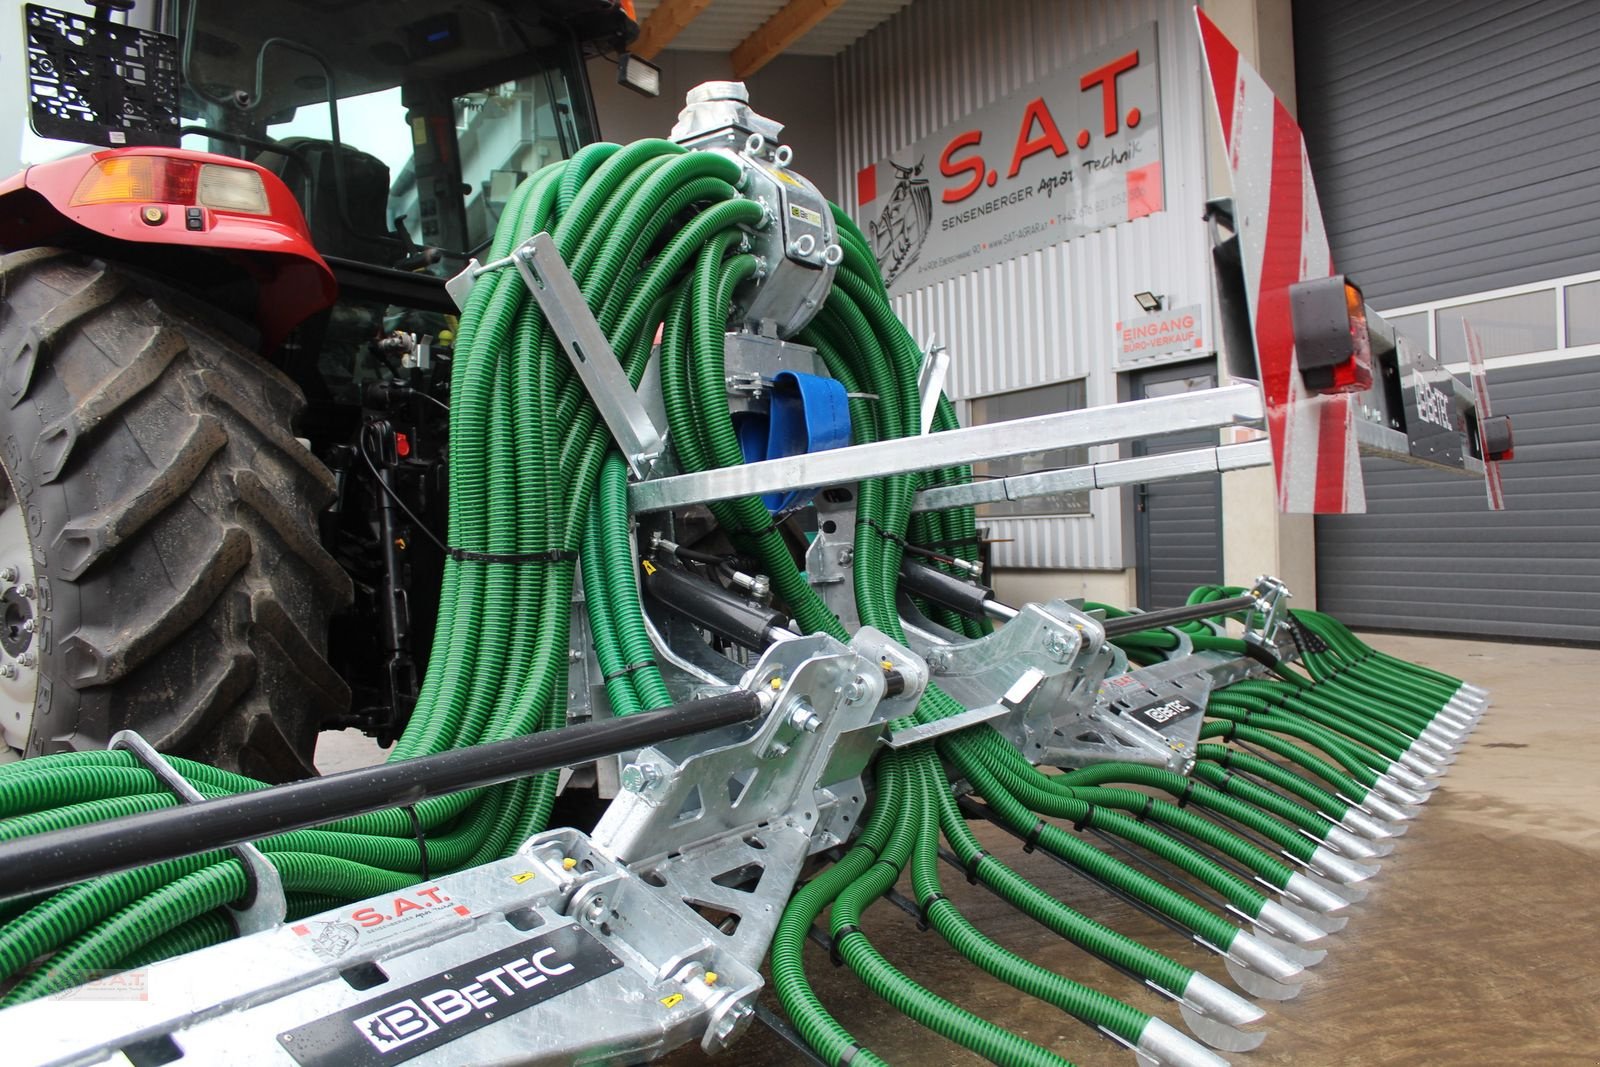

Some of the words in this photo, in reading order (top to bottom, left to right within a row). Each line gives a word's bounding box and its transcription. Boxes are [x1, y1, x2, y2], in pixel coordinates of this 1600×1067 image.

[940, 48, 1141, 203] S.A.T.
[942, 186, 1033, 231] SENSENBERGER
[1037, 170, 1074, 198] Agrar
[1082, 141, 1142, 174] Technik
[1123, 316, 1194, 340] EINGANG
[351, 886, 450, 927] S.A.T.
